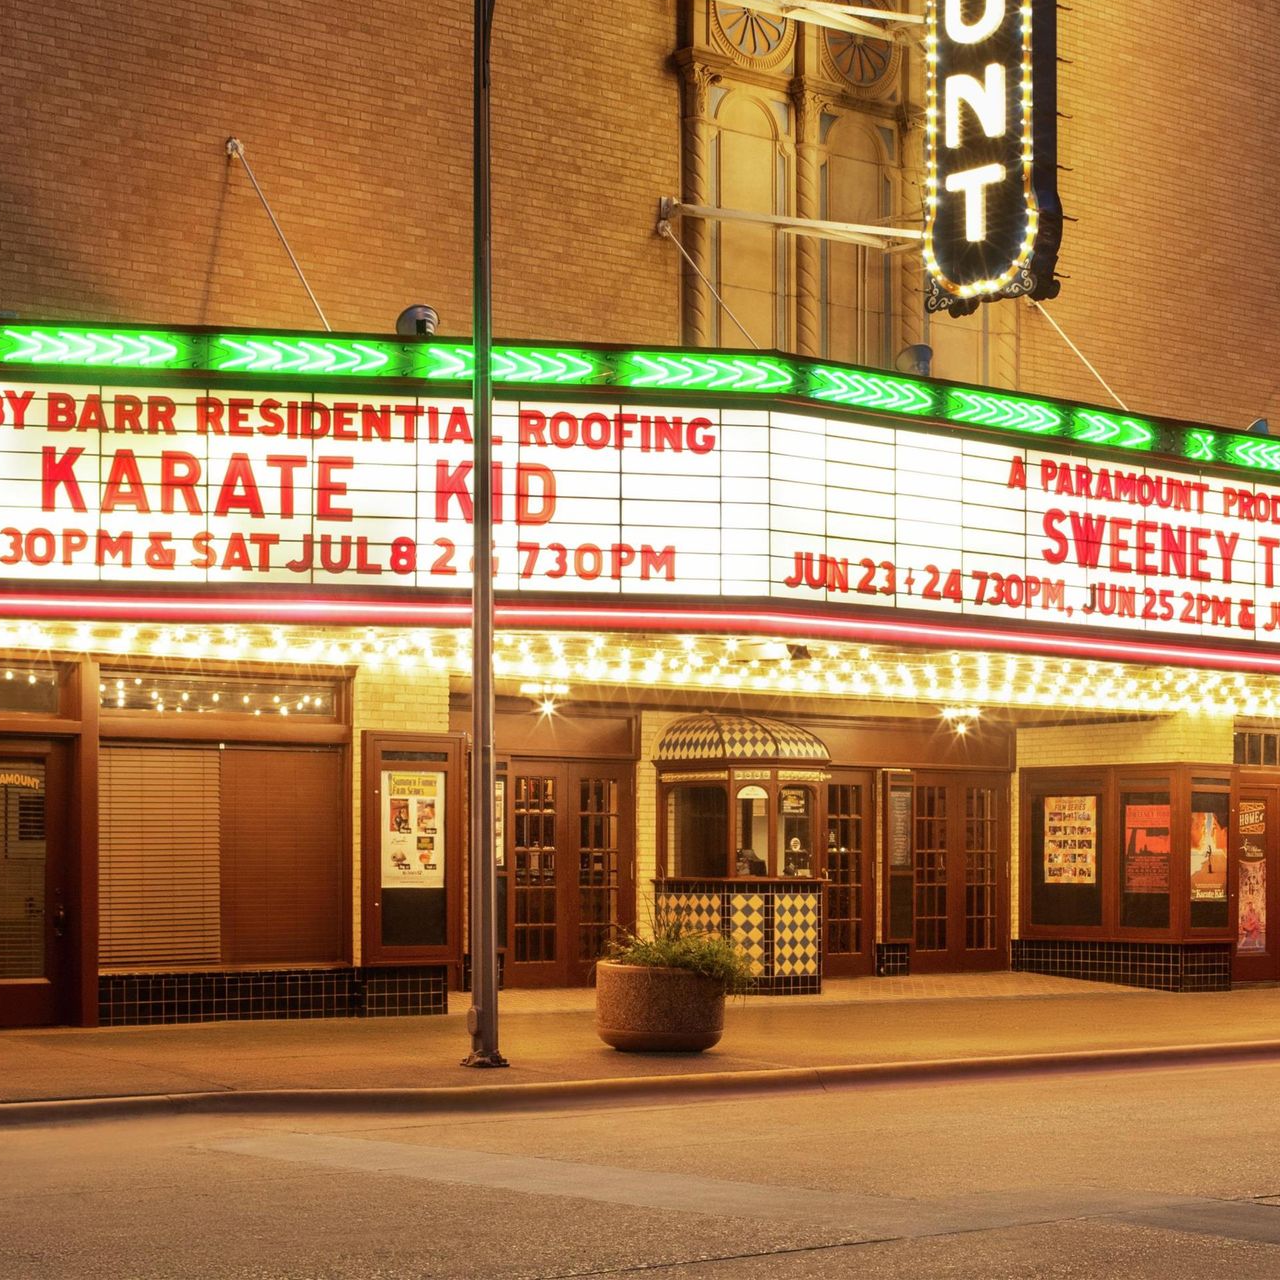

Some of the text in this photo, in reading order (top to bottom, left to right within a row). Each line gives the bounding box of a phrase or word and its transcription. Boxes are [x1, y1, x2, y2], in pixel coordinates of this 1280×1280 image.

[48, 393, 176, 434] BARR
[519, 410, 715, 454] ROOFING
[42, 446, 353, 521] KARATE
[436, 460, 556, 525] KID
[1008, 456, 1025, 489] A
[1041, 459, 1209, 515] PARAMOUNT
[146, 533, 175, 569] &
[193, 532, 279, 571] SAT
[288, 535, 381, 574] JUL
[390, 537, 416, 574] 8
[431, 539, 456, 575] 2
[517, 542, 675, 581] 730PM
[1041, 507, 1240, 584] SWEENEY
[785, 552, 848, 592] JUN
[858, 559, 896, 594] 23
[923, 566, 962, 602] 24
[972, 571, 1072, 617] 730PM,
[1083, 582, 1136, 618] JUN
[1141, 588, 1174, 621] 25
[1179, 592, 1231, 627] 2PM
[1238, 599, 1255, 630] &
[1240, 811, 1260, 826] HOME
